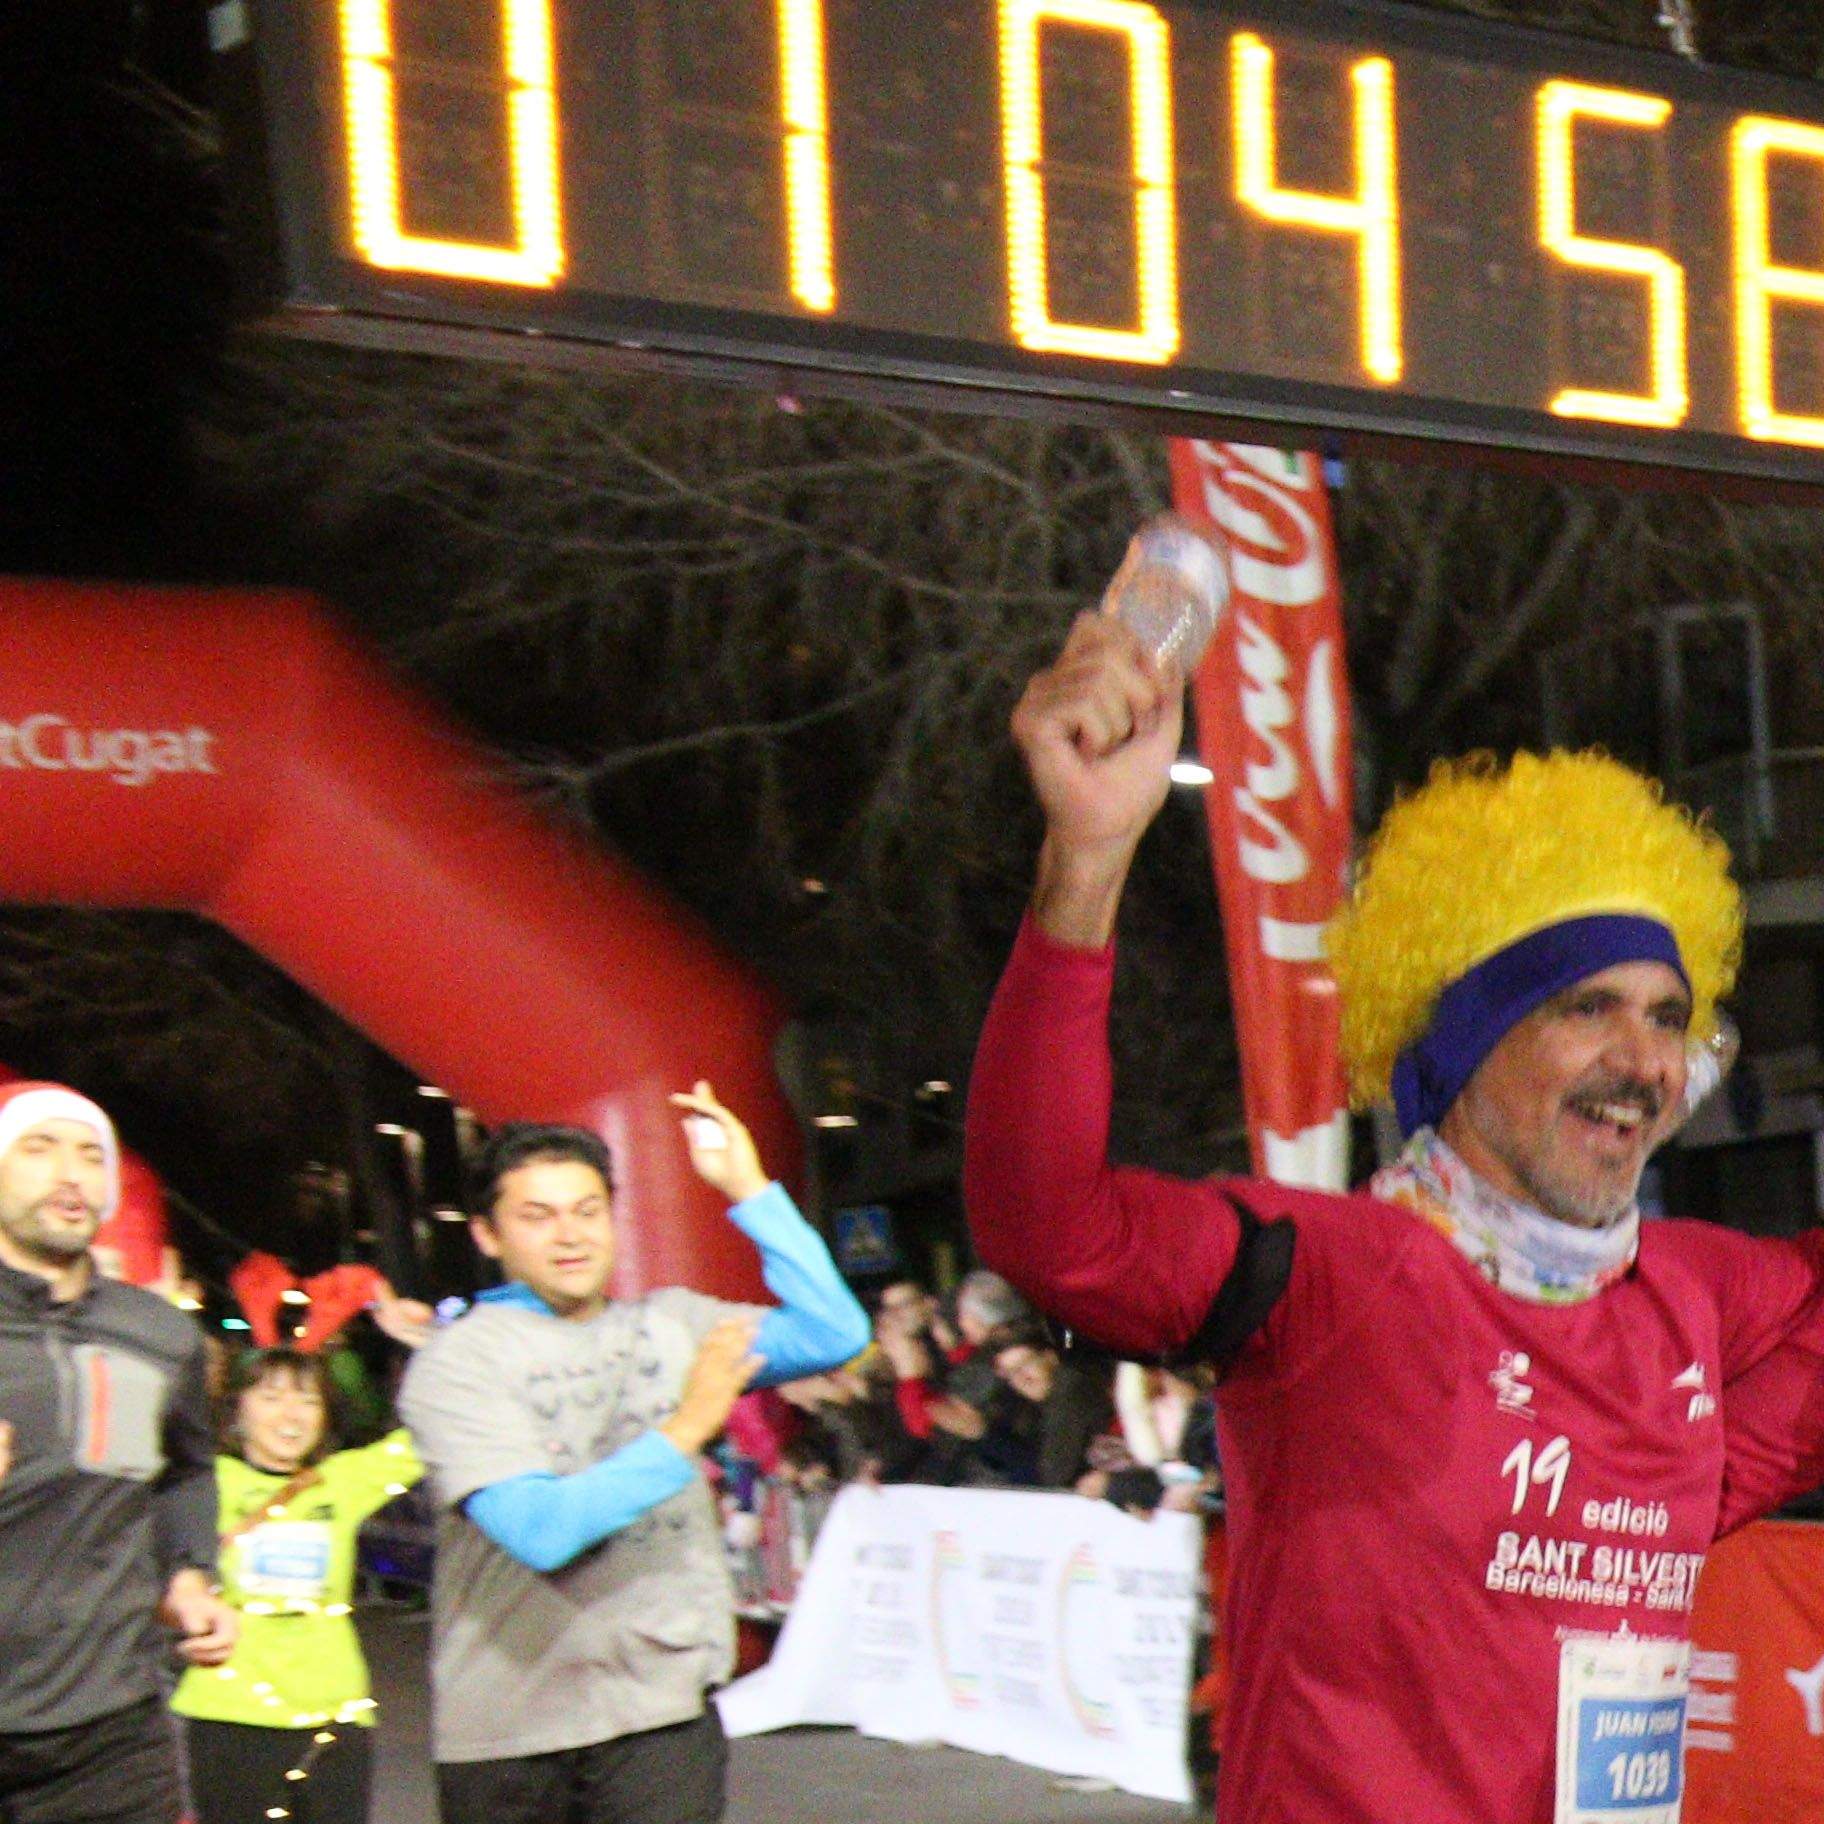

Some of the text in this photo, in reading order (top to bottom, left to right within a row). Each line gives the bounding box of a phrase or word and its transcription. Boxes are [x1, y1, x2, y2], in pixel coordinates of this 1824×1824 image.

[1000, 0, 1402, 384] 04
[1501, 1435, 1669, 1538] 19 edició
[1496, 1531, 1588, 1577] SANT
[1485, 1559, 1630, 1607] Barcelonesa
[1593, 1710, 1649, 1742] JUAN
